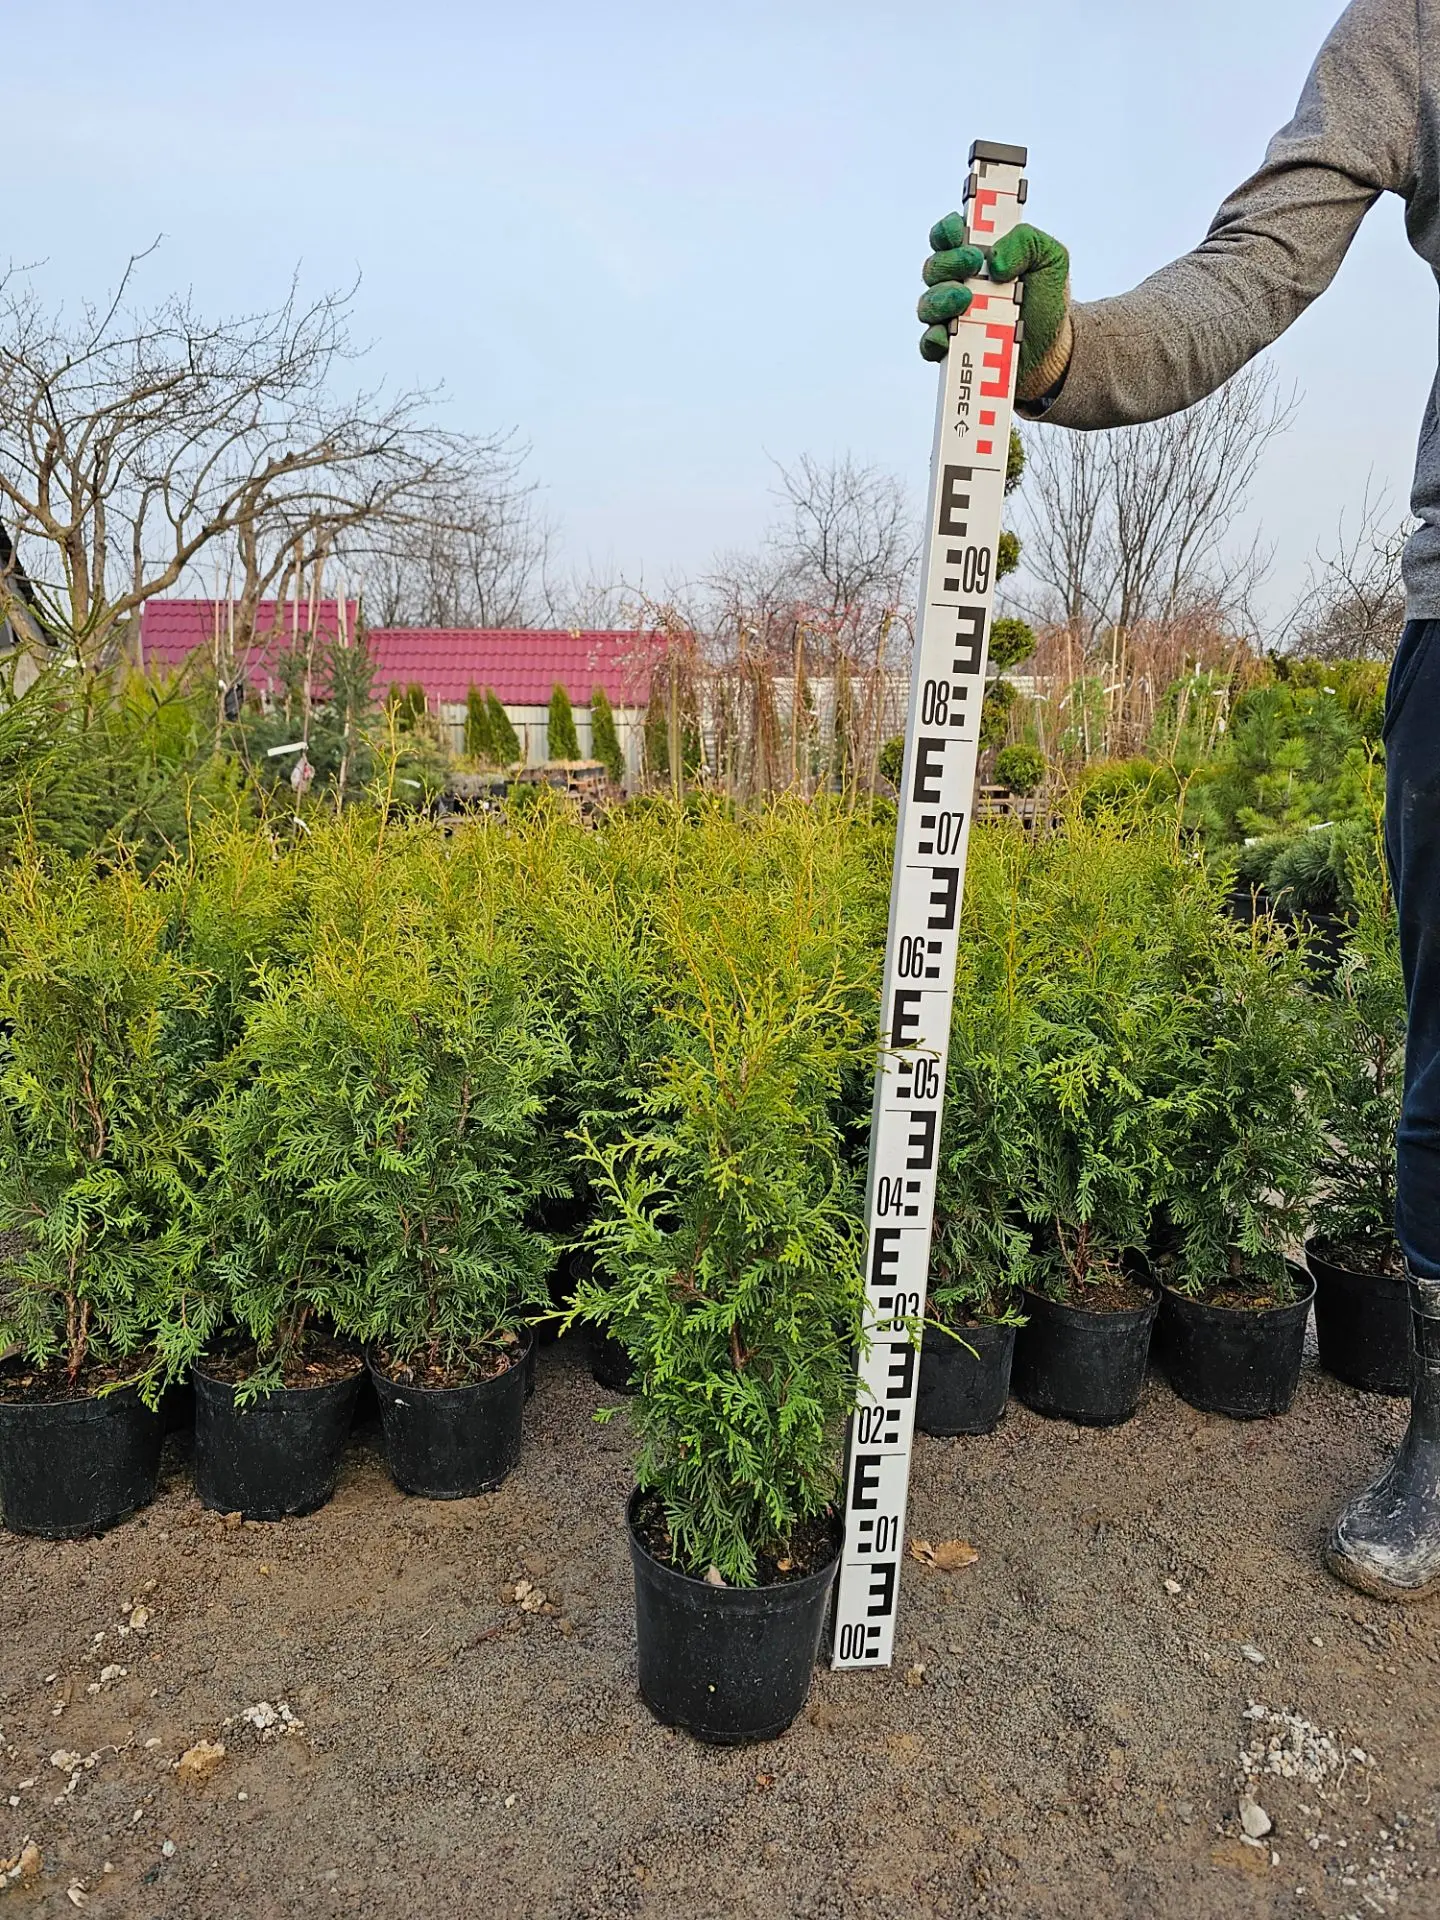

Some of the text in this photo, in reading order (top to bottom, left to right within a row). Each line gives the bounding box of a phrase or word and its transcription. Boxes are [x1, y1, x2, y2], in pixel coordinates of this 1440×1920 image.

[957, 352, 973, 416] ЗУБР
[962, 545, 991, 594] 09
[921, 679, 950, 726] 08
[936, 811, 965, 855] 07
[897, 935, 925, 978] 06
[914, 1058, 940, 1099] 05
[876, 1176, 903, 1216] 04
[858, 1406, 885, 1444] 02
[875, 1515, 899, 1552] 01
[839, 1623, 866, 1660] 00
